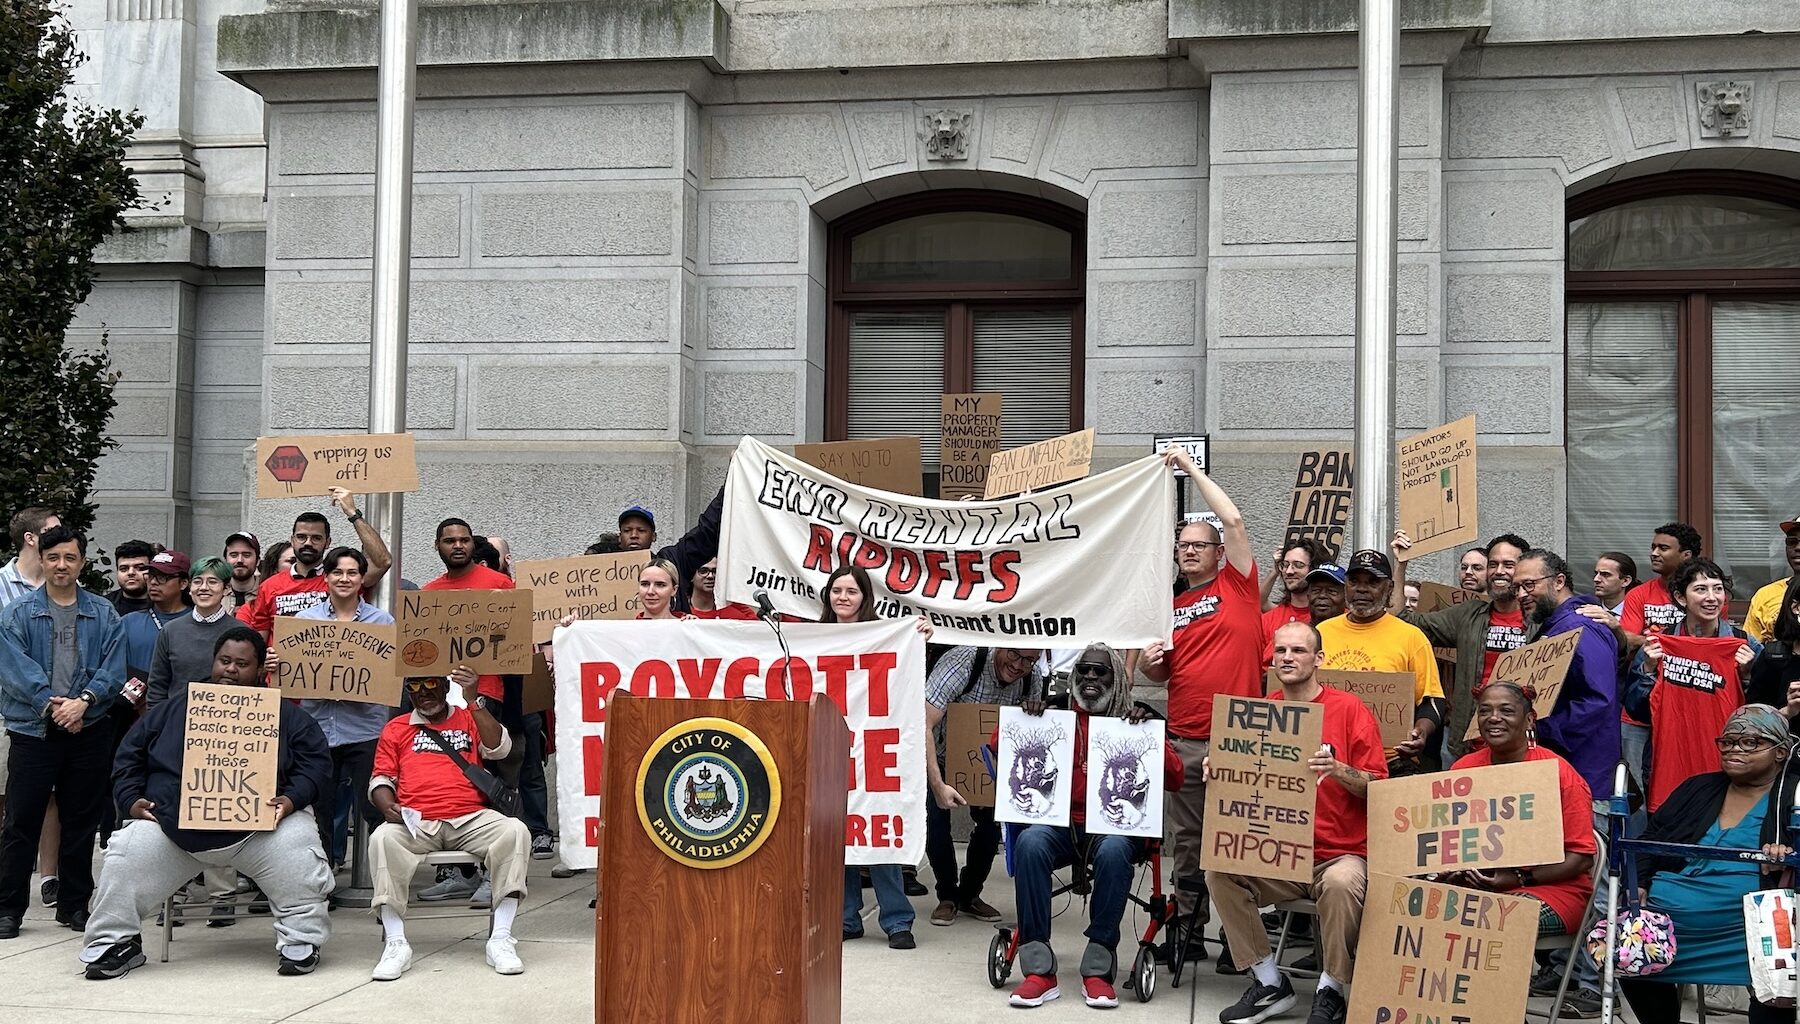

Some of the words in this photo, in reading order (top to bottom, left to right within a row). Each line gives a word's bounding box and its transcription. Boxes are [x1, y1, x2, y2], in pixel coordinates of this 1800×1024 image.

[954, 397, 982, 413] MY
[942, 426, 997, 437] MANAGER
[943, 414, 1001, 426] PROPERTY
[313, 446, 368, 464] ripping
[374, 446, 392, 459] us
[944, 438, 981, 449] SHOULD
[982, 440, 1001, 449] NOT
[953, 450, 975, 461] BE
[971, 451, 980, 462] A
[1401, 431, 1452, 456] ELEVATORS
[1401, 451, 1437, 469] SHOULD
[1438, 445, 1452, 456] GO
[1455, 439, 1467, 451] UP
[820, 452, 845, 469] SAY
[852, 449, 871, 468] NO
[875, 449, 892, 467] TO
[990, 450, 1017, 477] BAN
[1020, 439, 1067, 470] UNFAIR
[1295, 451, 1354, 489] BAN
[1402, 466, 1421, 481] NOT
[1424, 449, 1472, 472] LANDLORD
[336, 462, 368, 481] off!
[986, 470, 1034, 497] UTILITY
[1034, 461, 1066, 488] BILLS
[1402, 471, 1437, 490] PROFITS
[758, 459, 849, 525] END
[859, 493, 1081, 546] RENTAL
[1288, 490, 1352, 526] LATE
[566, 568, 601, 584] are
[605, 560, 642, 583] don
[803, 522, 1021, 604] RIPOFFS
[565, 584, 598, 599] with
[746, 566, 788, 593] Join
[790, 574, 816, 601] the
[998, 614, 1078, 640] Union
[402, 594, 443, 621] Not
[447, 602, 480, 617] one
[533, 608, 562, 622] eing
[569, 595, 618, 620] ripped
[625, 592, 643, 612] of
[401, 622, 430, 638] for
[438, 620, 460, 635] the
[464, 618, 512, 635] slumlord
[279, 625, 337, 650] TENANTS
[341, 627, 396, 660] DESERVE
[302, 648, 333, 659] WHAT
[339, 651, 355, 660] WE
[309, 640, 326, 649] TO
[323, 640, 342, 650] GET
[450, 634, 506, 664] NOT
[1496, 649, 1534, 681] OUR
[1531, 631, 1580, 668] HOMES
[278, 661, 324, 690] PAY
[329, 664, 371, 697] FOR
[580, 652, 897, 722] BOYCOTT
[1344, 679, 1397, 694] Deserve
[1527, 664, 1555, 688] NOT
[1690, 669, 1723, 684] UNION
[1693, 677, 1713, 690] DSA
[219, 693, 264, 707] can't
[1535, 682, 1560, 704] FIT
[189, 706, 242, 721] afford
[246, 712, 276, 722] our
[1226, 698, 1310, 736] RENT
[189, 718, 229, 734] basic
[231, 724, 280, 738] needs
[186, 738, 239, 757] paying
[243, 741, 269, 753] all
[671, 733, 705, 754] CITY
[710, 735, 732, 751] OF
[1218, 738, 1258, 756] JUNK
[1259, 742, 1303, 762] FEES
[205, 754, 250, 768] these
[186, 767, 259, 796] JUNK
[1210, 768, 1263, 787] UTILITY
[1262, 773, 1306, 794] FEES
[1431, 776, 1473, 800] NO
[187, 796, 260, 824] FEES!
[1218, 799, 1260, 821] LATE
[1262, 804, 1311, 826] FEES
[1393, 794, 1536, 833] SURPRISE
[652, 813, 763, 858] PHILADELPHIA
[1417, 824, 1505, 867] FEES
[1213, 831, 1313, 871] RIPOFF
[1389, 881, 1520, 933] ROBBERY
[1393, 925, 1424, 958] IN
[1444, 932, 1504, 971] THE
[1397, 964, 1472, 1004] FINE
